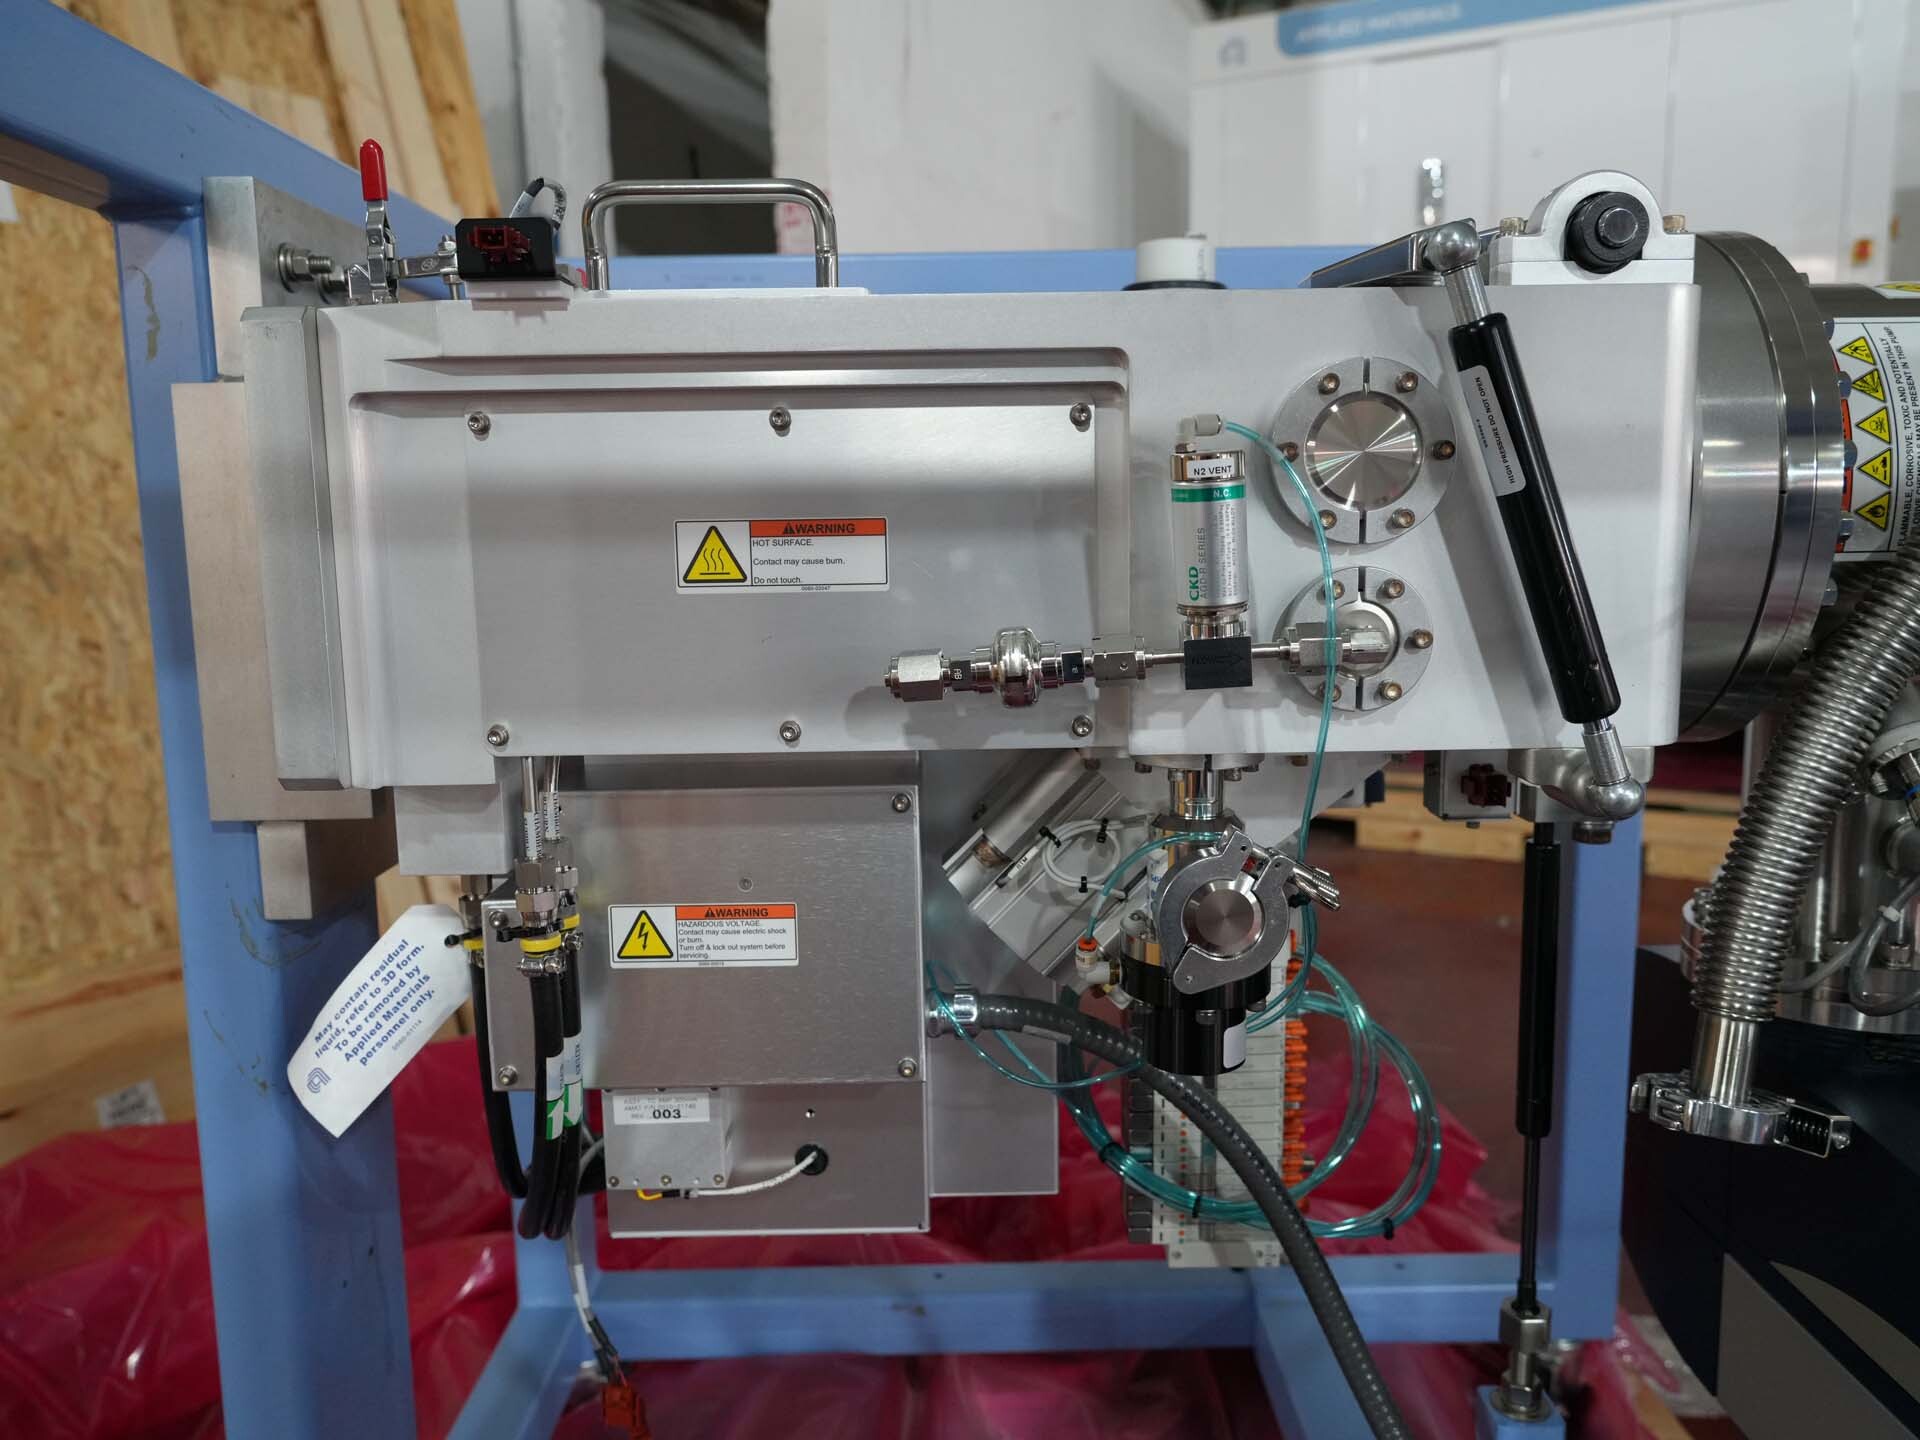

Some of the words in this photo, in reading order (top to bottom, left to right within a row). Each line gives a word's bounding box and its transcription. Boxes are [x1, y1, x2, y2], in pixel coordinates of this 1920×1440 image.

[1893, 344, 1906, 360] THIS
[1881, 338, 1903, 384] POTENTIALLY
[1900, 361, 1910, 369] IN
[1474, 376, 1486, 397] OPEN
[1897, 386, 1908, 404] AND
[1903, 371, 1919, 407] PRESENT
[1482, 398, 1491, 414] NOT
[1487, 414, 1496, 426] DO
[1901, 405, 1911, 431] TOXIC
[1912, 409, 1920, 421] BE
[1491, 427, 1509, 464] PRESSURE
[1905, 432, 1914, 487] CORROSIVE,
[1193, 466, 1207, 476] N2
[1209, 465, 1232, 475] VENT
[1504, 463, 1516, 485] HIGH
[795, 522, 856, 535] WARNING
[752, 539, 770, 547] HOT
[772, 538, 814, 547] SURFACE.
[1197, 527, 1207, 565] SERIES
[753, 557, 782, 566] Contact
[783, 559, 800, 568] may
[801, 558, 824, 566] cause
[825, 557, 845, 566] burn.
[753, 576, 765, 585] Do
[767, 576, 778, 585] not
[1188, 566, 1200, 601] CKD
[715, 907, 769, 918] WARNING
[678, 920, 724, 928] HAZARDOUS
[678, 928, 704, 936] Contact
[705, 929, 719, 937] may
[720, 928, 740, 936] cause
[742, 927, 767, 935] electric
[767, 927, 786, 935] shock
[740, 944, 763, 952] system
[764, 943, 786, 951] before
[314, 1021, 334, 1044] May
[334, 982, 370, 1021] contain
[369, 938, 410, 982] residual
[314, 1027, 346, 1059] liquid,
[345, 998, 370, 1026] refer
[369, 986, 382, 999] to
[380, 969, 397, 986] 3D
[395, 944, 425, 970] form.
[335, 1037, 349, 1052] To
[349, 1024, 363, 1039] be
[363, 977, 407, 1024] removed
[405, 964, 422, 981] by
[343, 1020, 383, 1062] Applied
[382, 973, 431, 1022] Materials
[359, 1012, 410, 1067] personnel
[409, 988, 436, 1014] only.
[652, 1108, 681, 1119] 003
